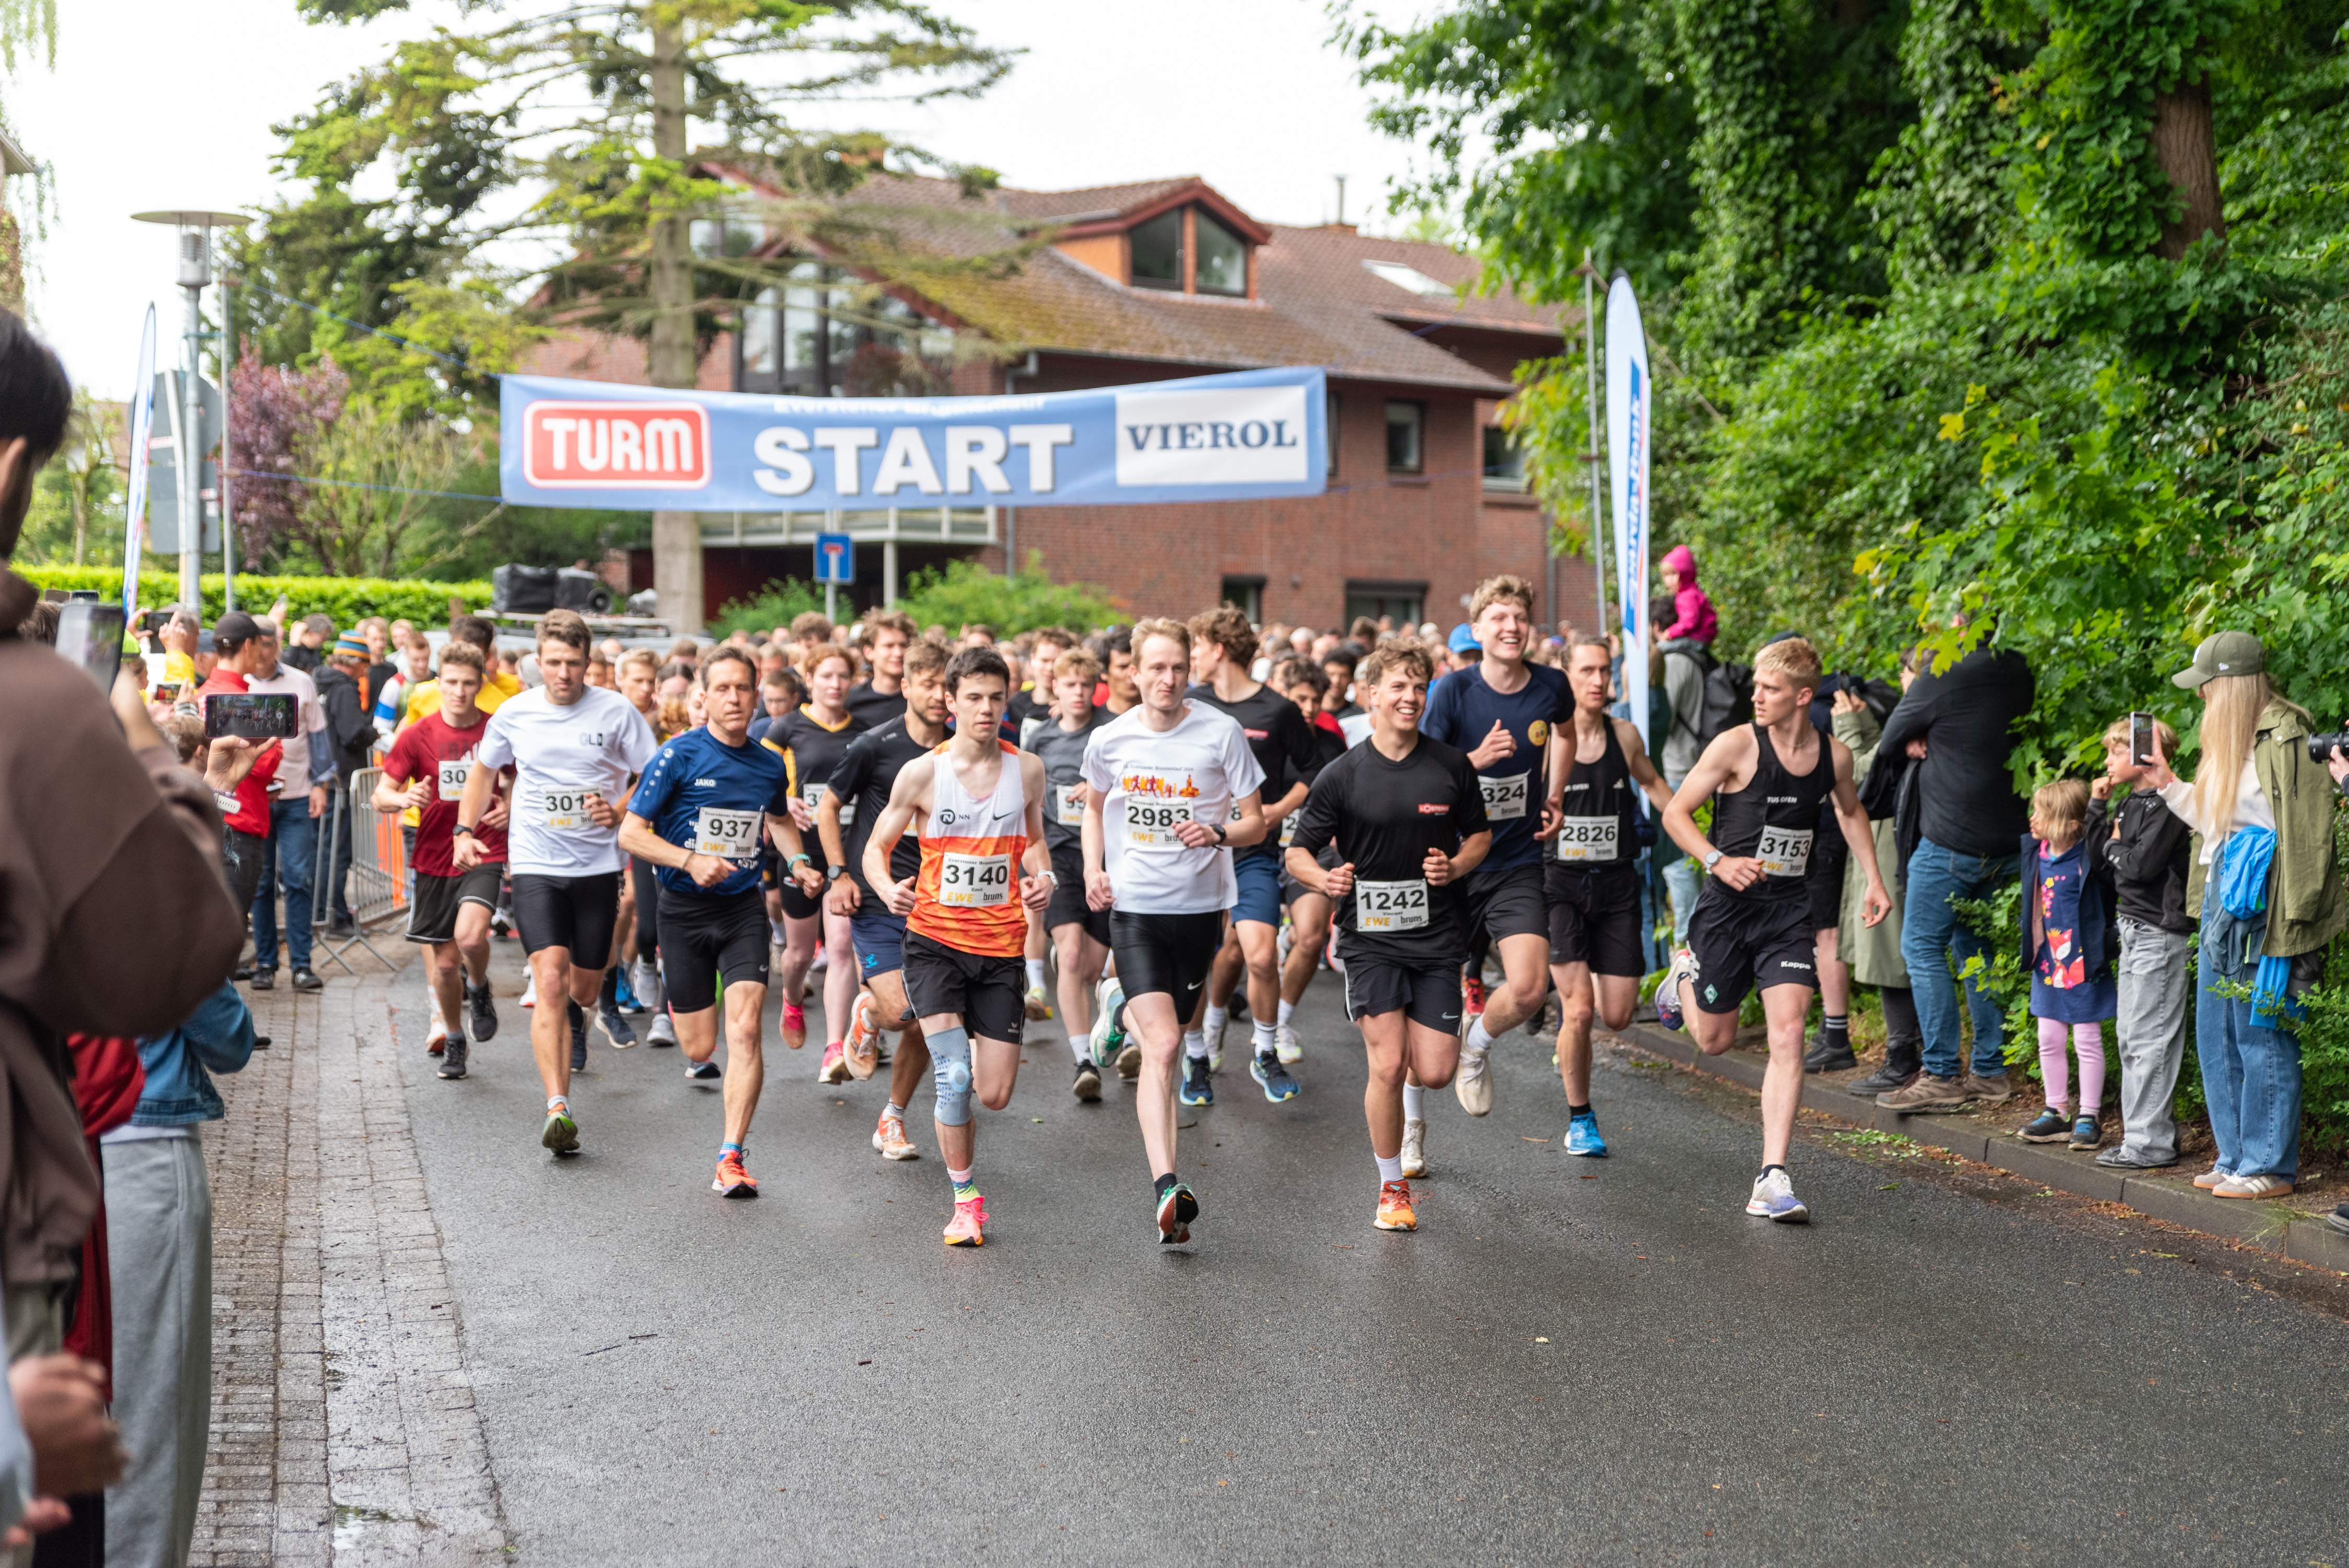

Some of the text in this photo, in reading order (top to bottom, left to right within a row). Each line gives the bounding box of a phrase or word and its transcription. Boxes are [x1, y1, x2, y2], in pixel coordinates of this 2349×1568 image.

[1124, 419, 1297, 450] VIEROL
[542, 418, 694, 472] TURM
[753, 424, 1073, 496] START
[694, 778, 717, 787] JAKO
[545, 792, 601, 812] 301
[1128, 805, 1190, 826] 2983
[709, 818, 752, 838] 937
[1133, 831, 1154, 842] EWE
[1562, 825, 1616, 842] 2826
[702, 842, 727, 852] EWE
[1564, 848, 1587, 857] EWE
[1761, 837, 1810, 857] 3153
[944, 864, 1007, 885] 3140
[947, 892, 1003, 902] EWE bruns
[1360, 889, 1425, 910] 1242
[1365, 917, 1391, 926] EWE
[1401, 915, 1422, 924] bruns
[1781, 960, 1811, 969] Kappa
